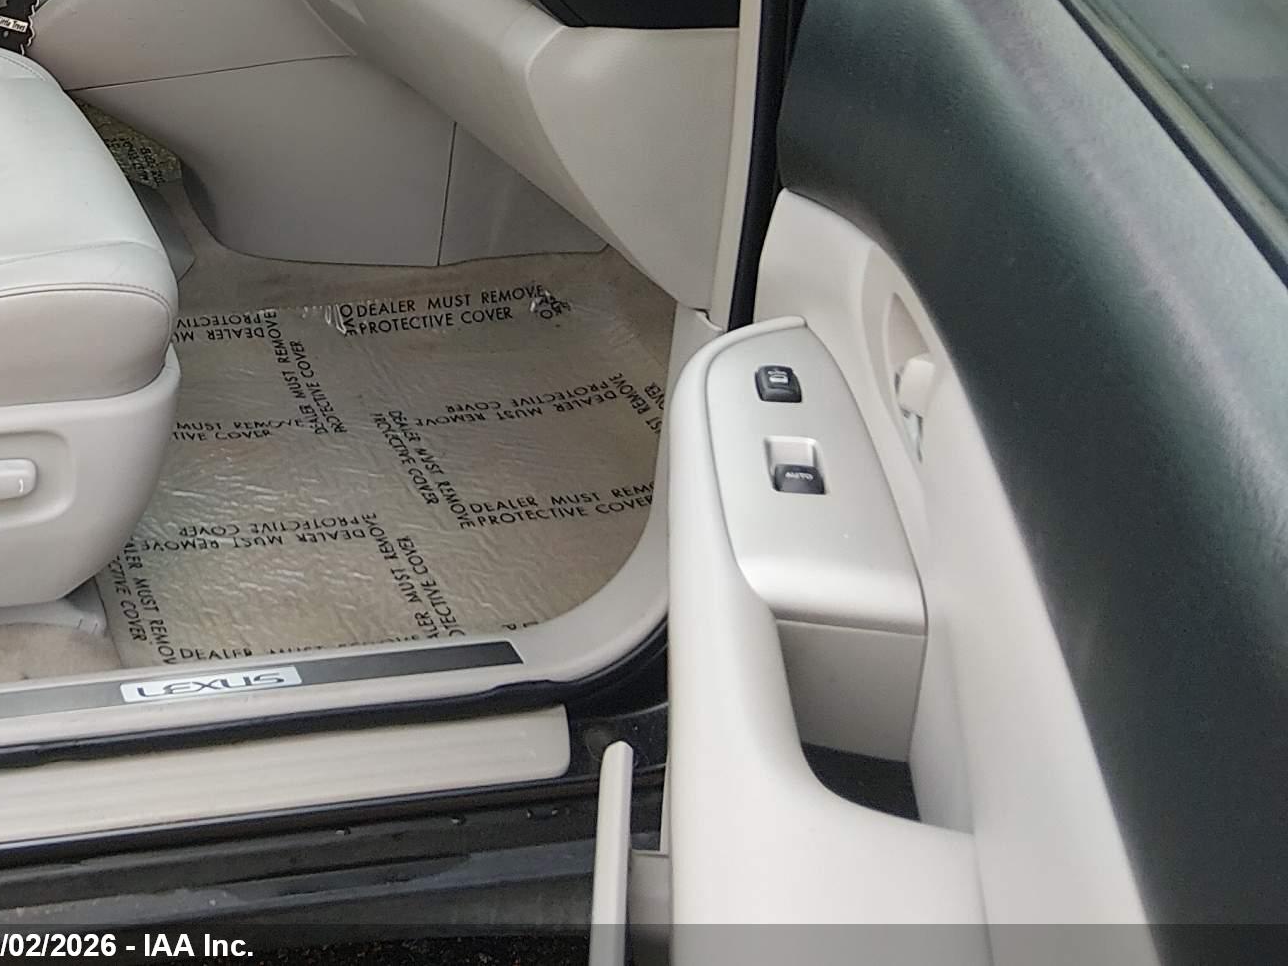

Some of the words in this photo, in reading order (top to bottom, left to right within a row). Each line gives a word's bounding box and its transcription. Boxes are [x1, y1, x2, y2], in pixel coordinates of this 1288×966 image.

[357, 299, 416, 318] DEALER
[428, 293, 472, 310] MUST
[481, 284, 544, 304] REMOVE
[207, 327, 265, 341] DEALER
[360, 312, 454, 335] PROTECTIVE
[461, 306, 514, 324] COVER
[264, 311, 291, 364] REMOVE
[289, 340, 315, 379] COVER
[282, 370, 306, 399] MUST
[512, 381, 609, 408] PROTECTIVE
[446, 400, 501, 414] COVER
[496, 406, 543, 421] MUST
[556, 390, 618, 412] DEALER
[215, 430, 271, 441] COVER
[408, 468, 440, 505] COVER
[436, 481, 476, 530] REMOVE
[470, 496, 539, 514] DEALER
[551, 491, 601, 506] MUST
[478, 505, 589, 528] PROTECTIVE
[232, 535, 284, 549] MUST
[397, 535, 429, 576] COVER
[132, 577, 160, 613] MUST
[390, 567, 423, 605] MUST
[120, 600, 148, 642] COVER
[136, 672, 286, 698] LEXUS
